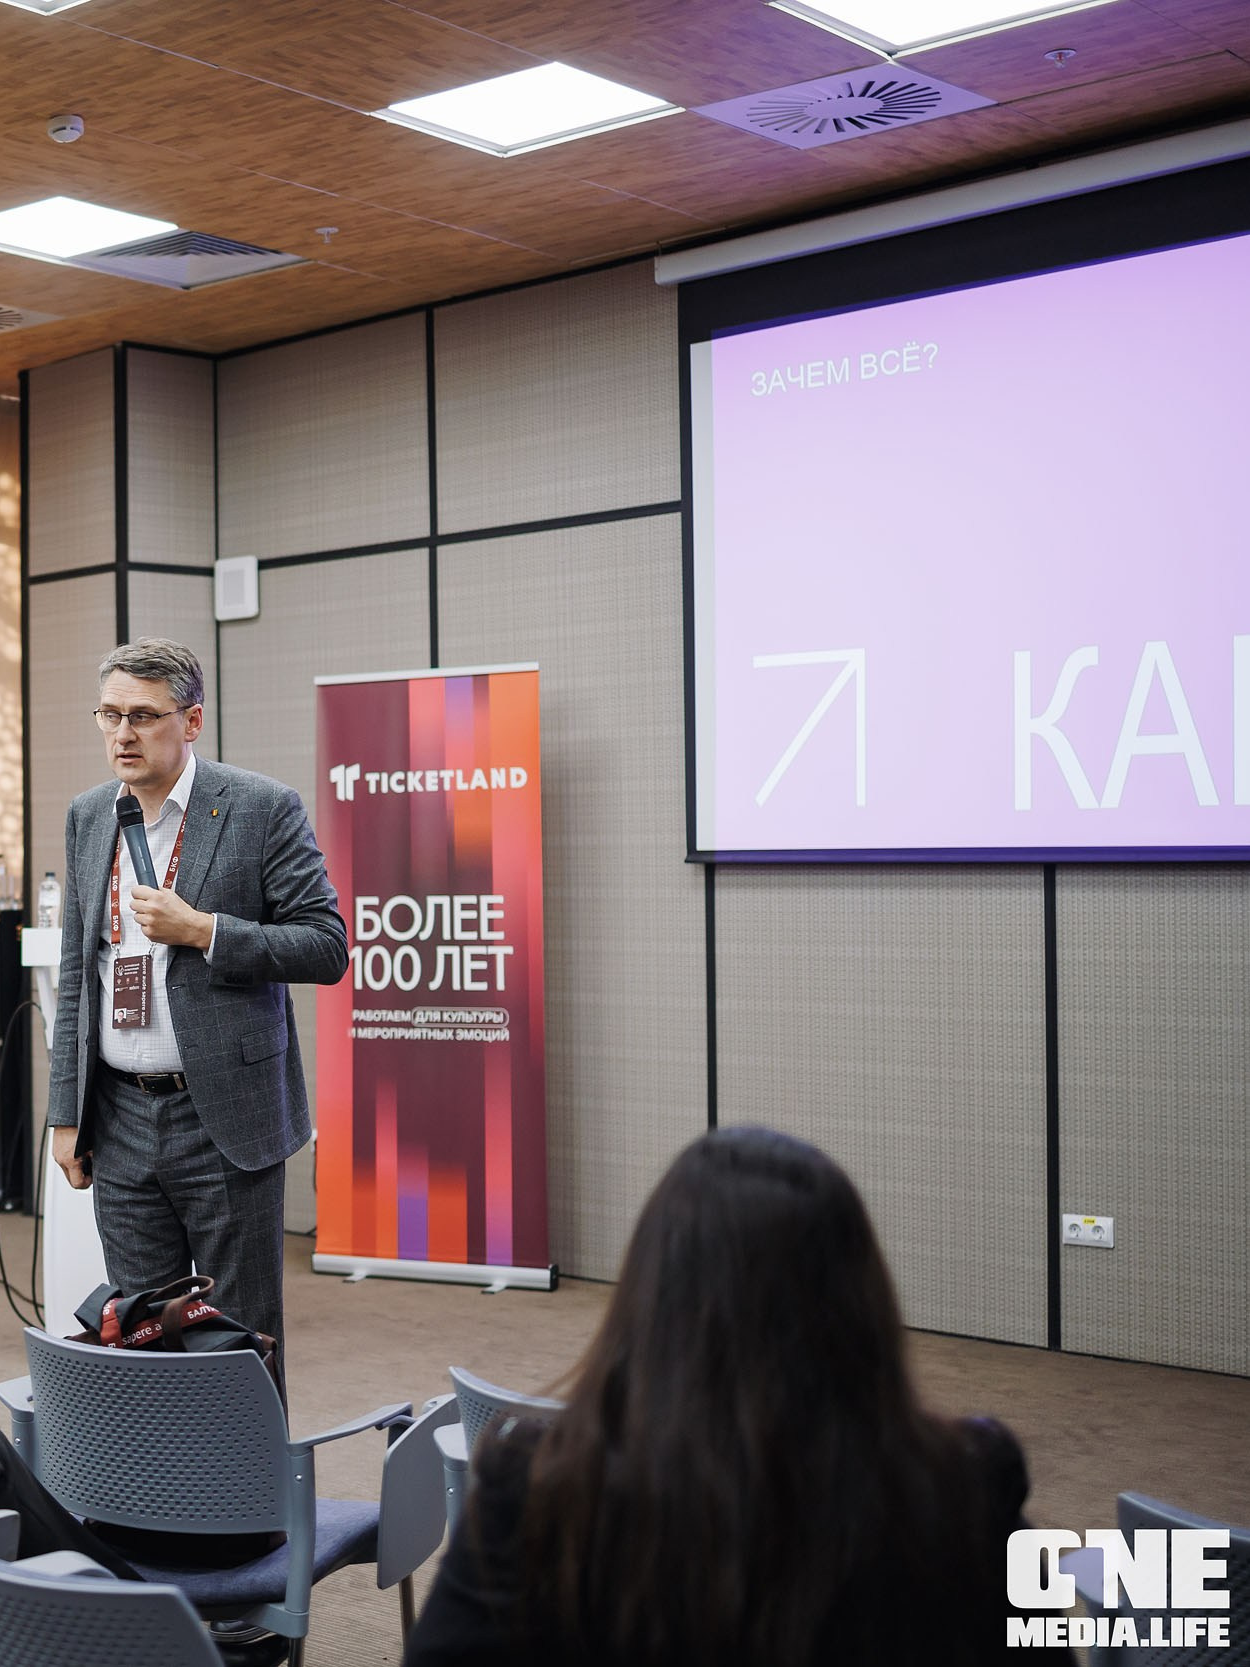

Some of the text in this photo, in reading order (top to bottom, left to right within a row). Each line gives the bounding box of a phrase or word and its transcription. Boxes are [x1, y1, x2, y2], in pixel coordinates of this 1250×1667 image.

[750, 340, 940, 397] ЗАЧЕМ ВСЁ?
[1013, 634, 1250, 812] КА
[365, 767, 528, 794] TICKETLAND
[169, 856, 179, 873] БКФ
[356, 895, 505, 941] БОЛЕЕ
[349, 945, 514, 991] 100 ЛЕТ
[352, 1009, 504, 1024] РАБОТАЕМ ДЛЯ КУЛЬТУРЫ
[357, 1027, 455, 1041] МЕРОПРИЯТНЫХ
[456, 1026, 510, 1042] ЭМОЦИЙ
[121, 1326, 153, 1346] sapere
